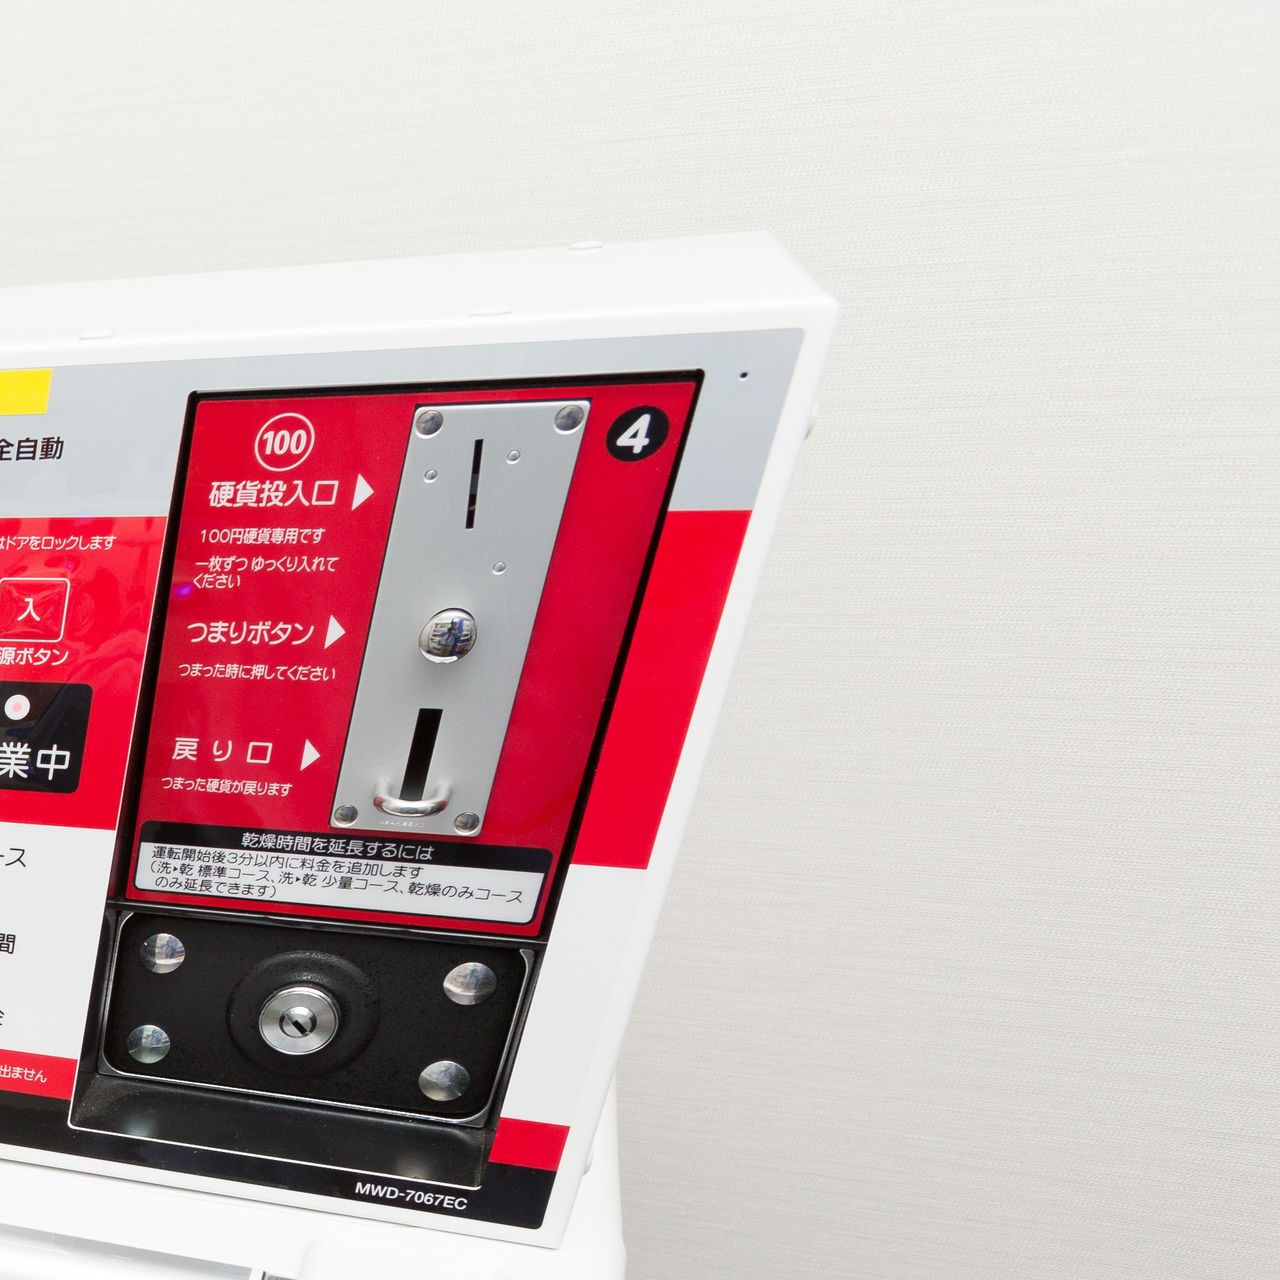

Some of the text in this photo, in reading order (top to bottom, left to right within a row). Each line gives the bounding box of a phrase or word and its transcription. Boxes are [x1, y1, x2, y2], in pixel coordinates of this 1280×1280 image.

[262, 430, 307, 455] 100
[208, 479, 339, 508] 硬貨投入口
[200, 528, 326, 545] 100円硬貨専用です
[192, 572, 241, 590] ください
[17, 597, 41, 622] 入
[187, 620, 315, 646] つまりボタン
[178, 663, 336, 682] つまった時に押してください
[172, 737, 273, 764] 戻り口
[161, 777, 293, 797] つまった硬貨が戻ります
[240, 832, 434, 861] 乾燥時間を延長するには
[151, 845, 424, 879] 運転開始後3分以内に料金を追加します
[354, 1182, 468, 1211] MWD-7067EC
